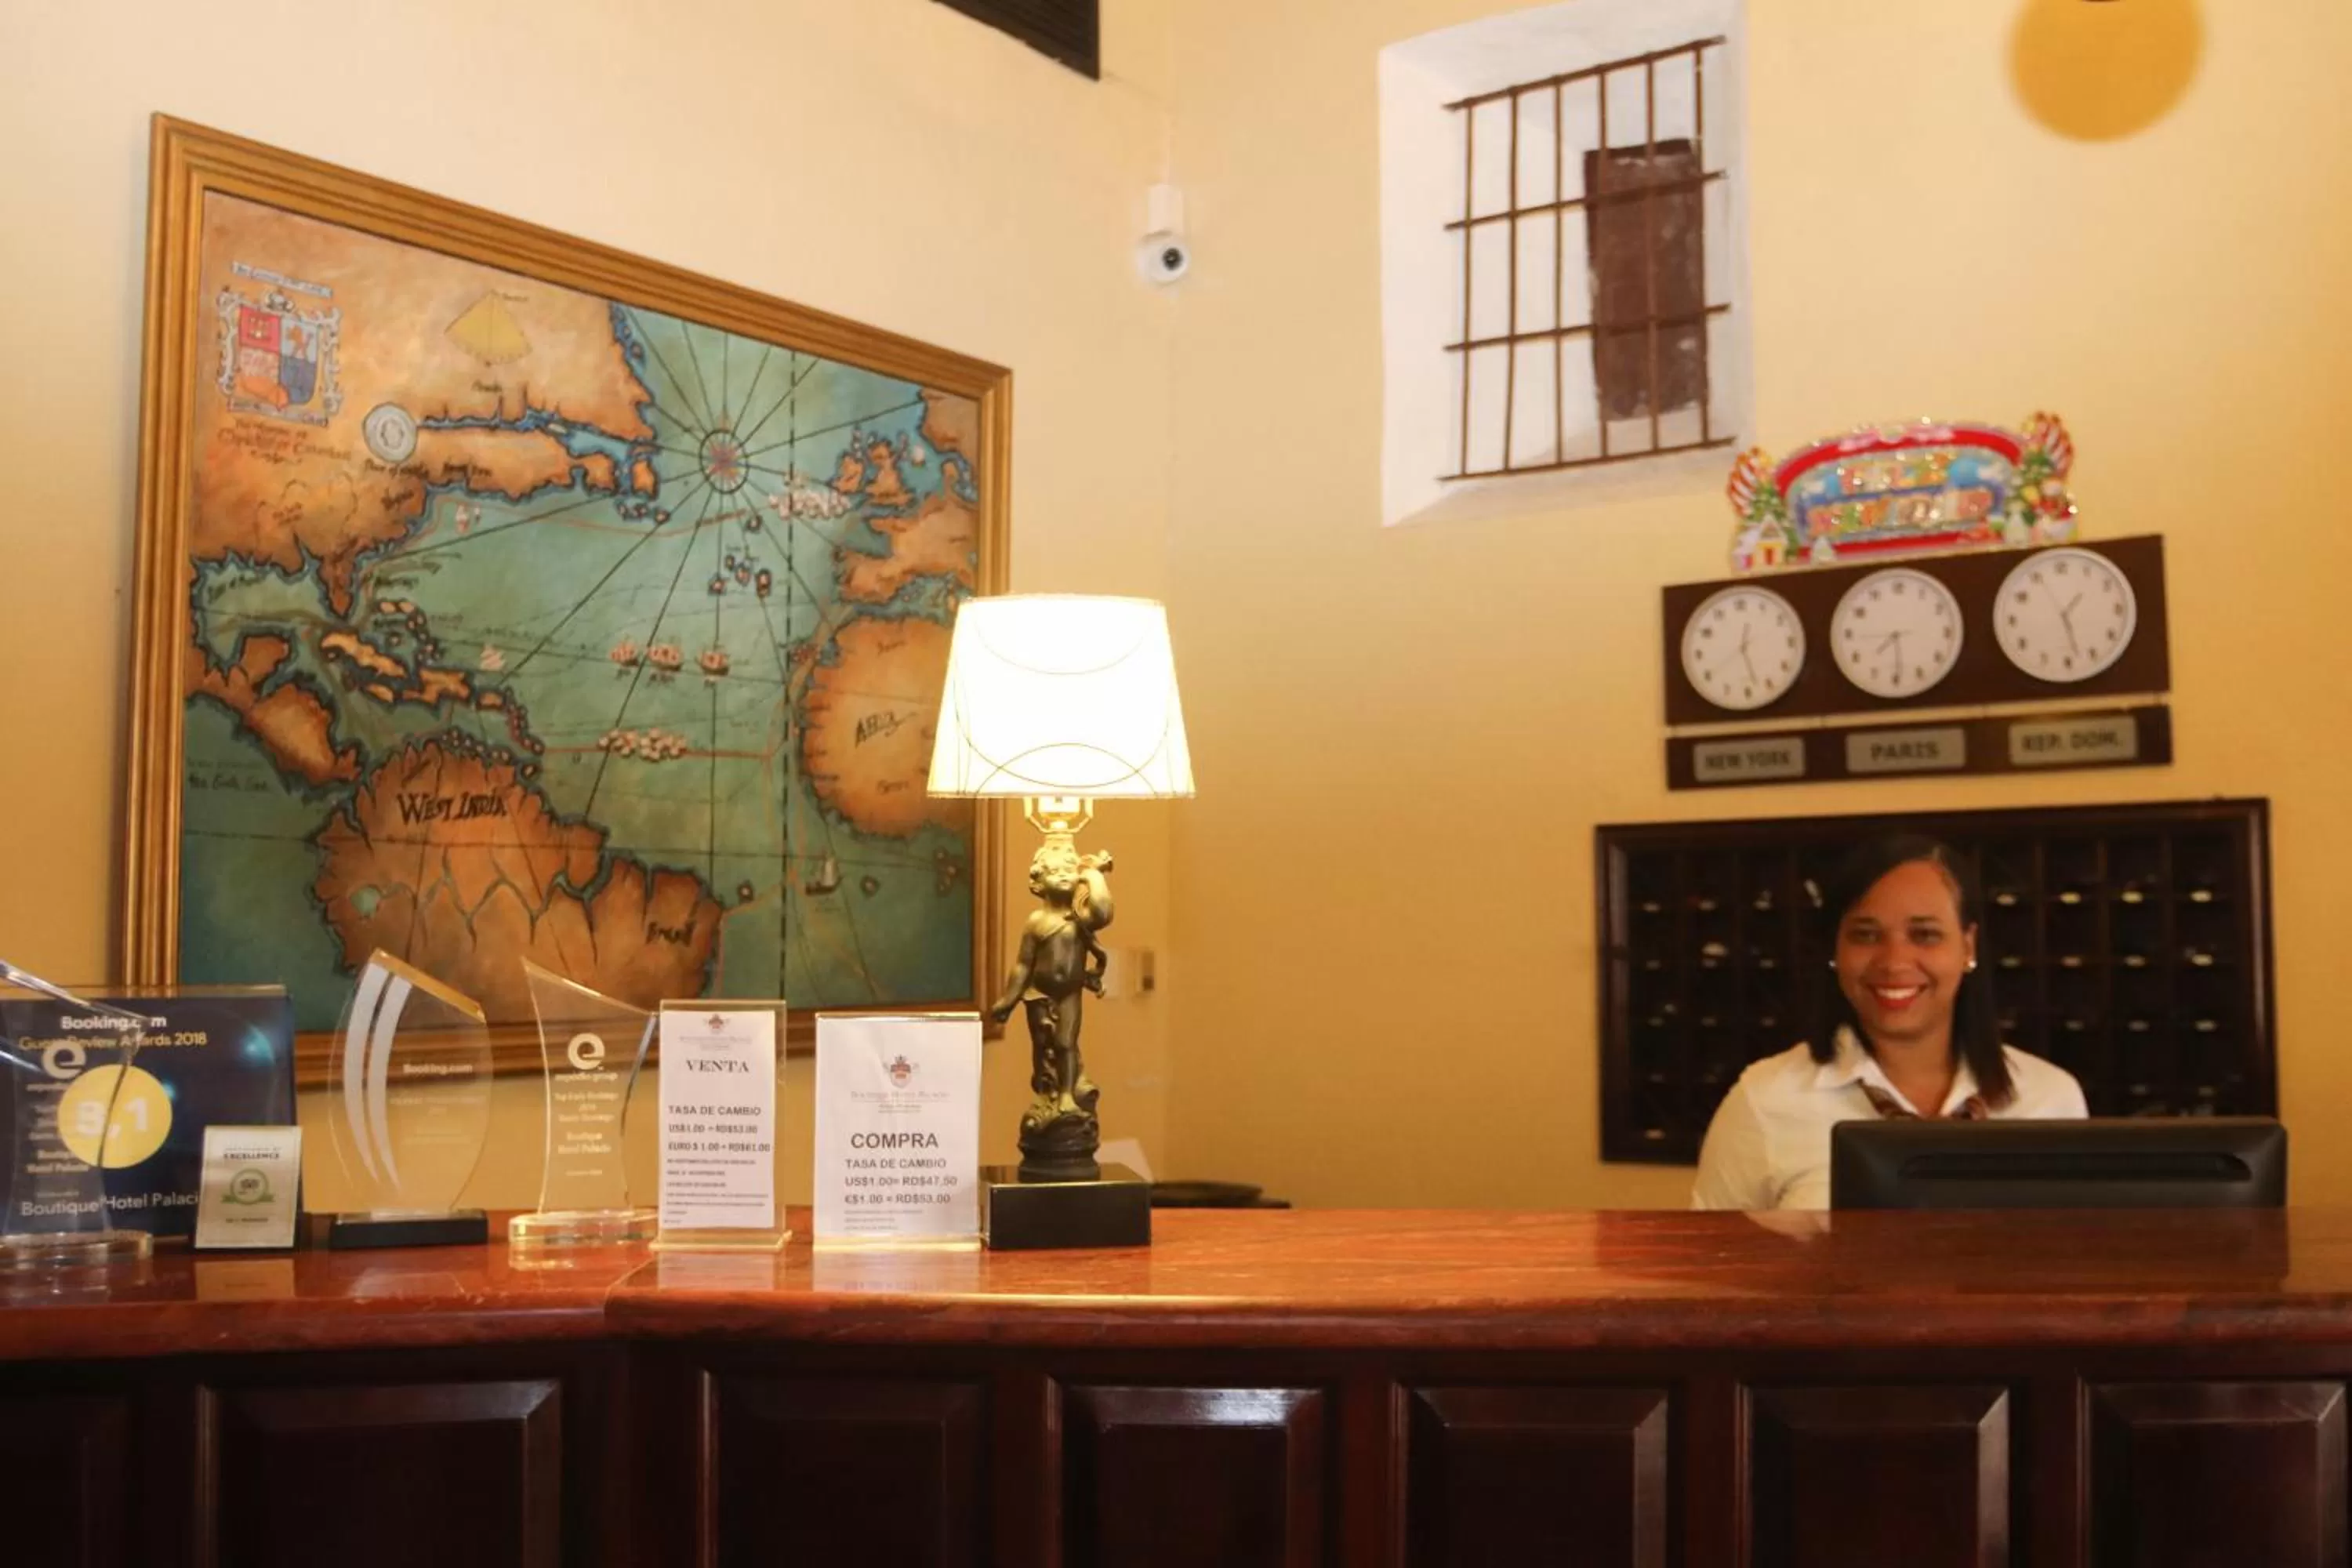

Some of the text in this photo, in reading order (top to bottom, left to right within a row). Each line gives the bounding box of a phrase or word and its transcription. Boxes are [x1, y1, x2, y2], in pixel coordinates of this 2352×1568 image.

[1870, 742, 1940, 760] PARIS
[60, 1015, 167, 1031] Booking.cm
[119, 1033, 172, 1048] Aards
[174, 1032, 208, 1047] 2018
[685, 1058, 750, 1073] VENTA
[668, 1105, 761, 1116] TASA DE CAMBIO
[851, 1132, 938, 1149] COMPRA
[845, 1158, 947, 1169] TASA DE CAMBIO
[20, 1191, 199, 1216] Boutique Hotel Palaci
